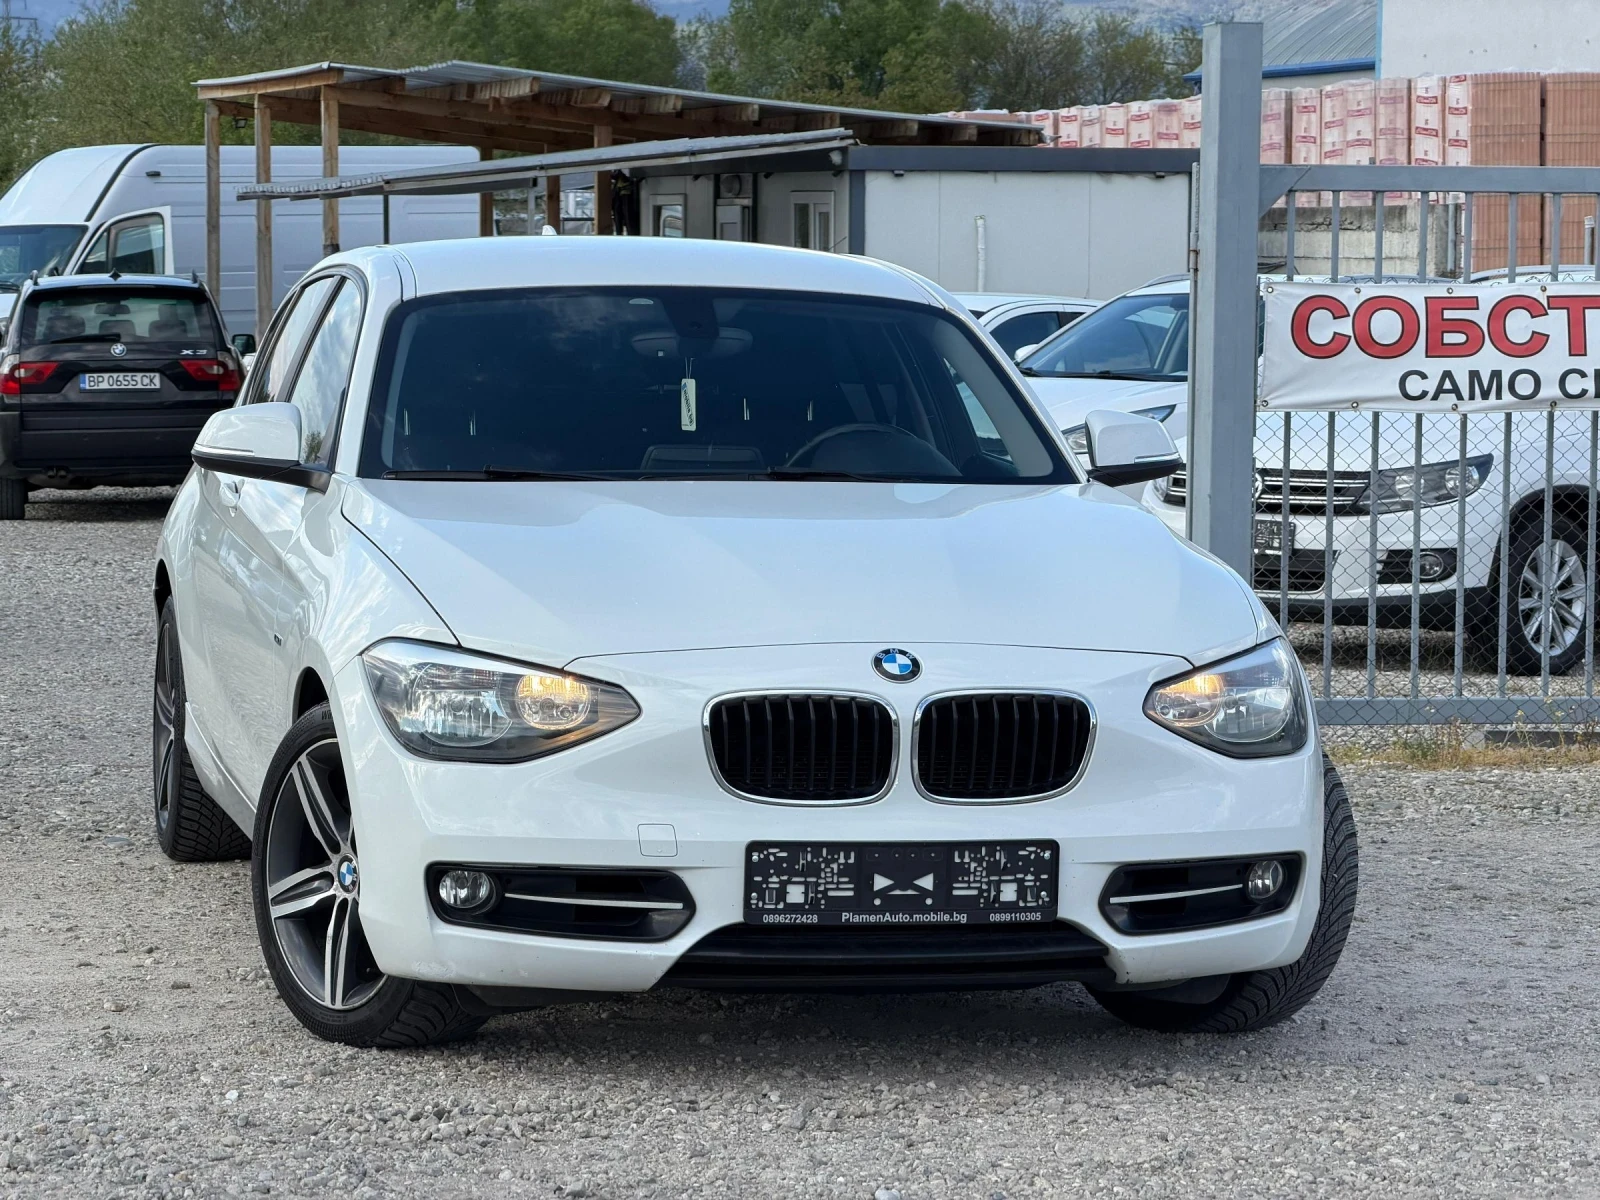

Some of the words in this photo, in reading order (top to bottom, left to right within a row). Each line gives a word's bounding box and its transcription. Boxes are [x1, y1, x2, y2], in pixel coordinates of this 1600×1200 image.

[1290, 294, 1600, 359] СОБСТ
[88, 374, 105, 388] BP
[107, 374, 138, 387] 0655
[140, 374, 157, 387] CK
[1398, 368, 1542, 401] САМО
[1558, 368, 1600, 400] С
[762, 914, 818, 923] 0896272428
[841, 912, 967, 923] PlamenAuto.mobile.bg
[989, 912, 1041, 922] 0899110305
